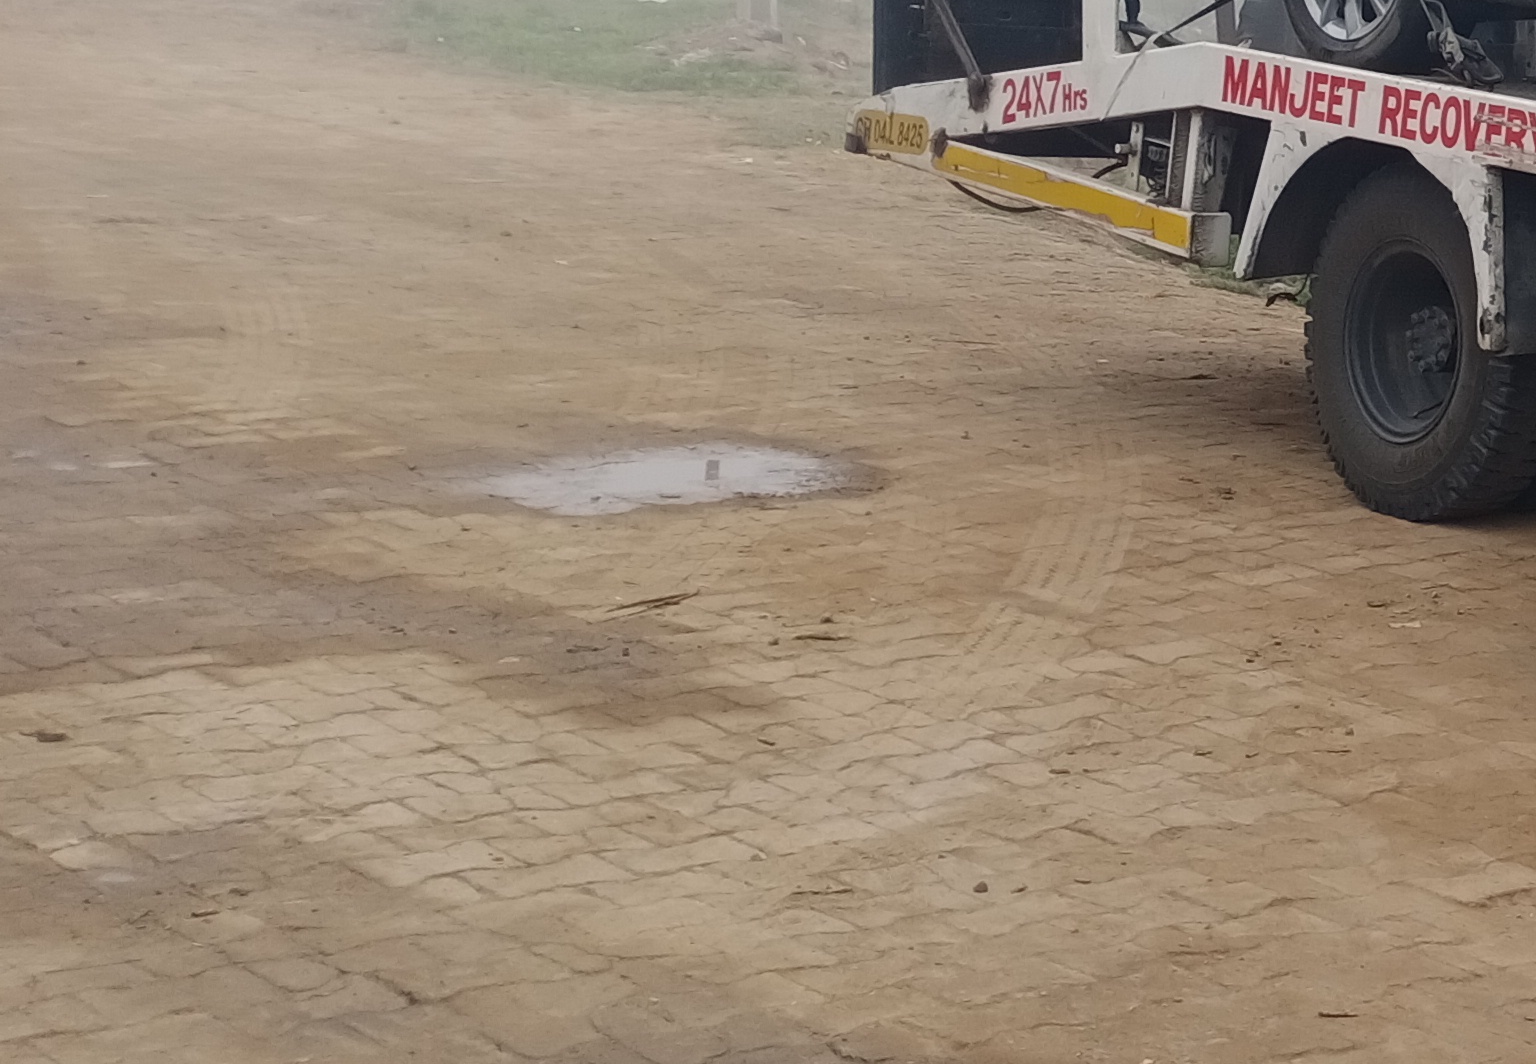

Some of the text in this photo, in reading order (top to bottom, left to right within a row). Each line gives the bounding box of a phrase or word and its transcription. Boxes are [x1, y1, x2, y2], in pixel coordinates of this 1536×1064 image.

[1002, 70, 1088, 125] 24X7 Hrs
[1222, 55, 1366, 129] MANJEET
[897, 121, 923, 148] 8425
